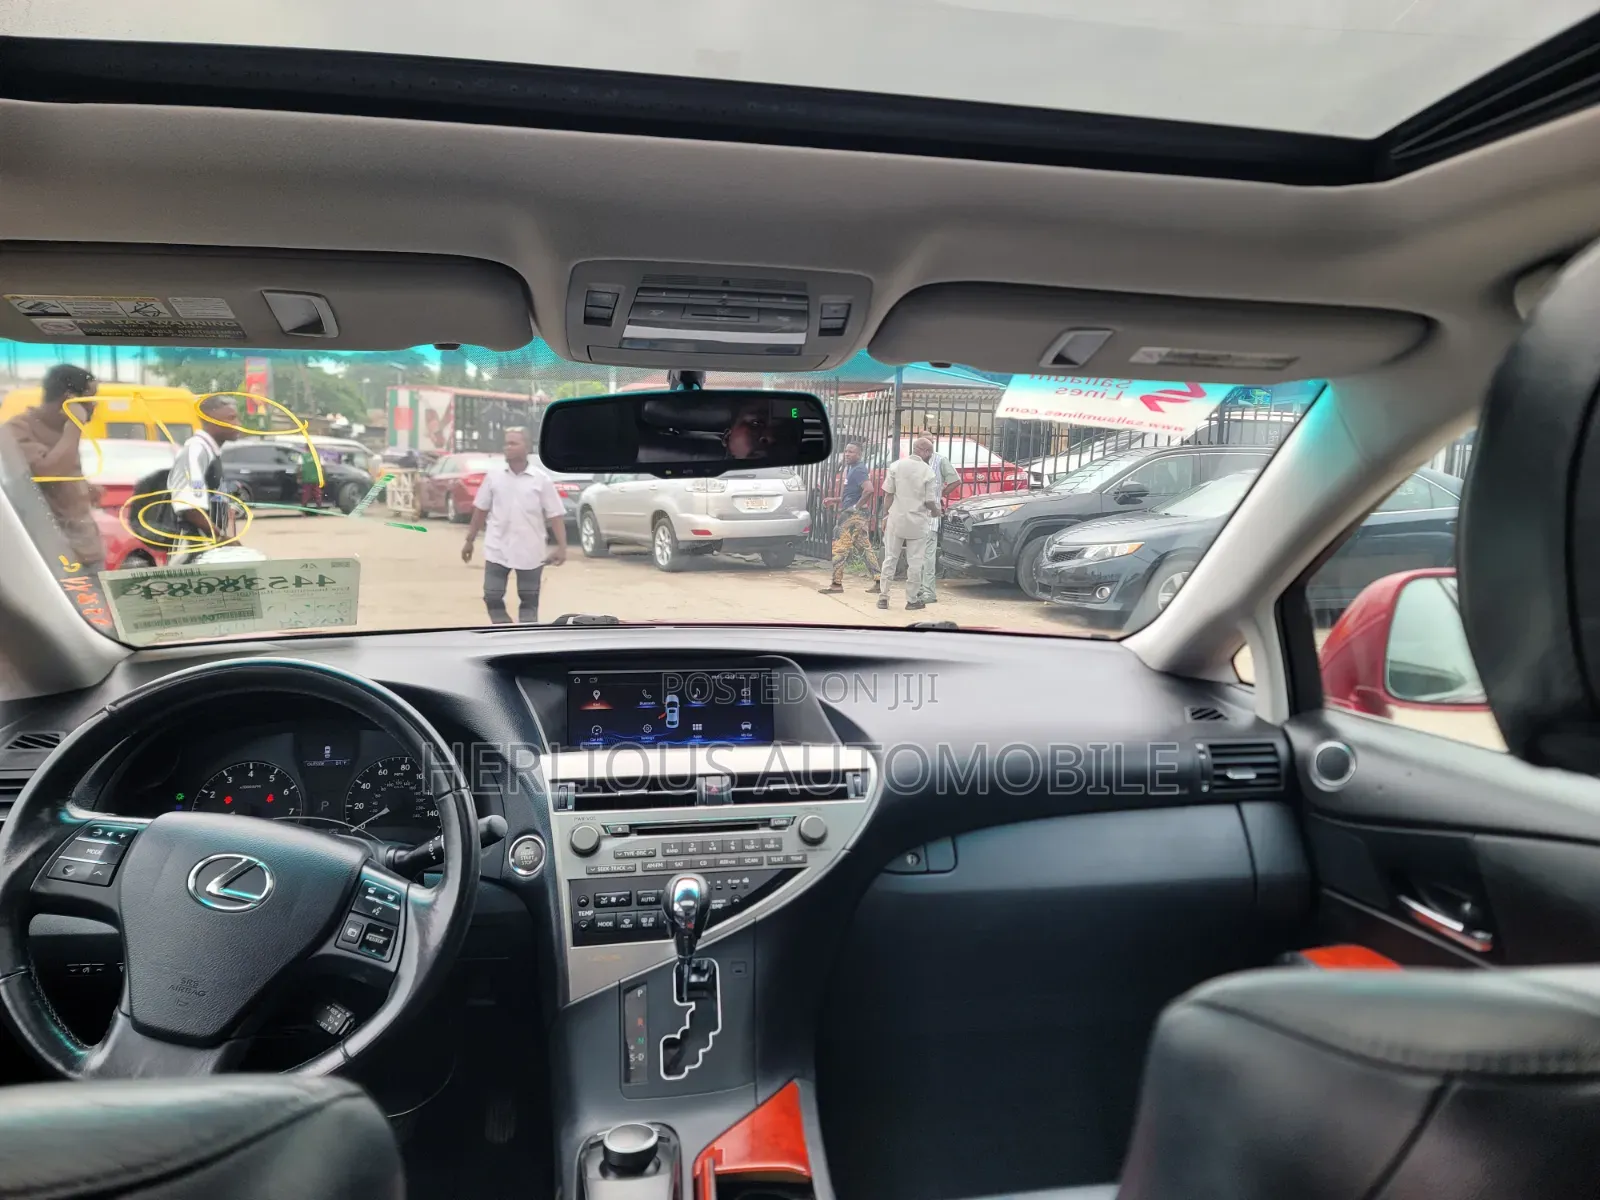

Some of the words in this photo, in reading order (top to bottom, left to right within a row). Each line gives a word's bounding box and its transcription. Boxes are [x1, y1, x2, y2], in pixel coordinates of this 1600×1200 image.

[151, 319, 238, 327] WARNING
[791, 407, 798, 419] E
[247, 770, 254, 778] 4
[269, 774, 275, 782] 5
[226, 776, 233, 784] 3
[360, 782, 371, 790] 40
[209, 791, 216, 799] 2
[354, 802, 365, 810] 20
[288, 808, 295, 816] 7
[597, 920, 614, 928] MODE
[637, 989, 643, 998] P
